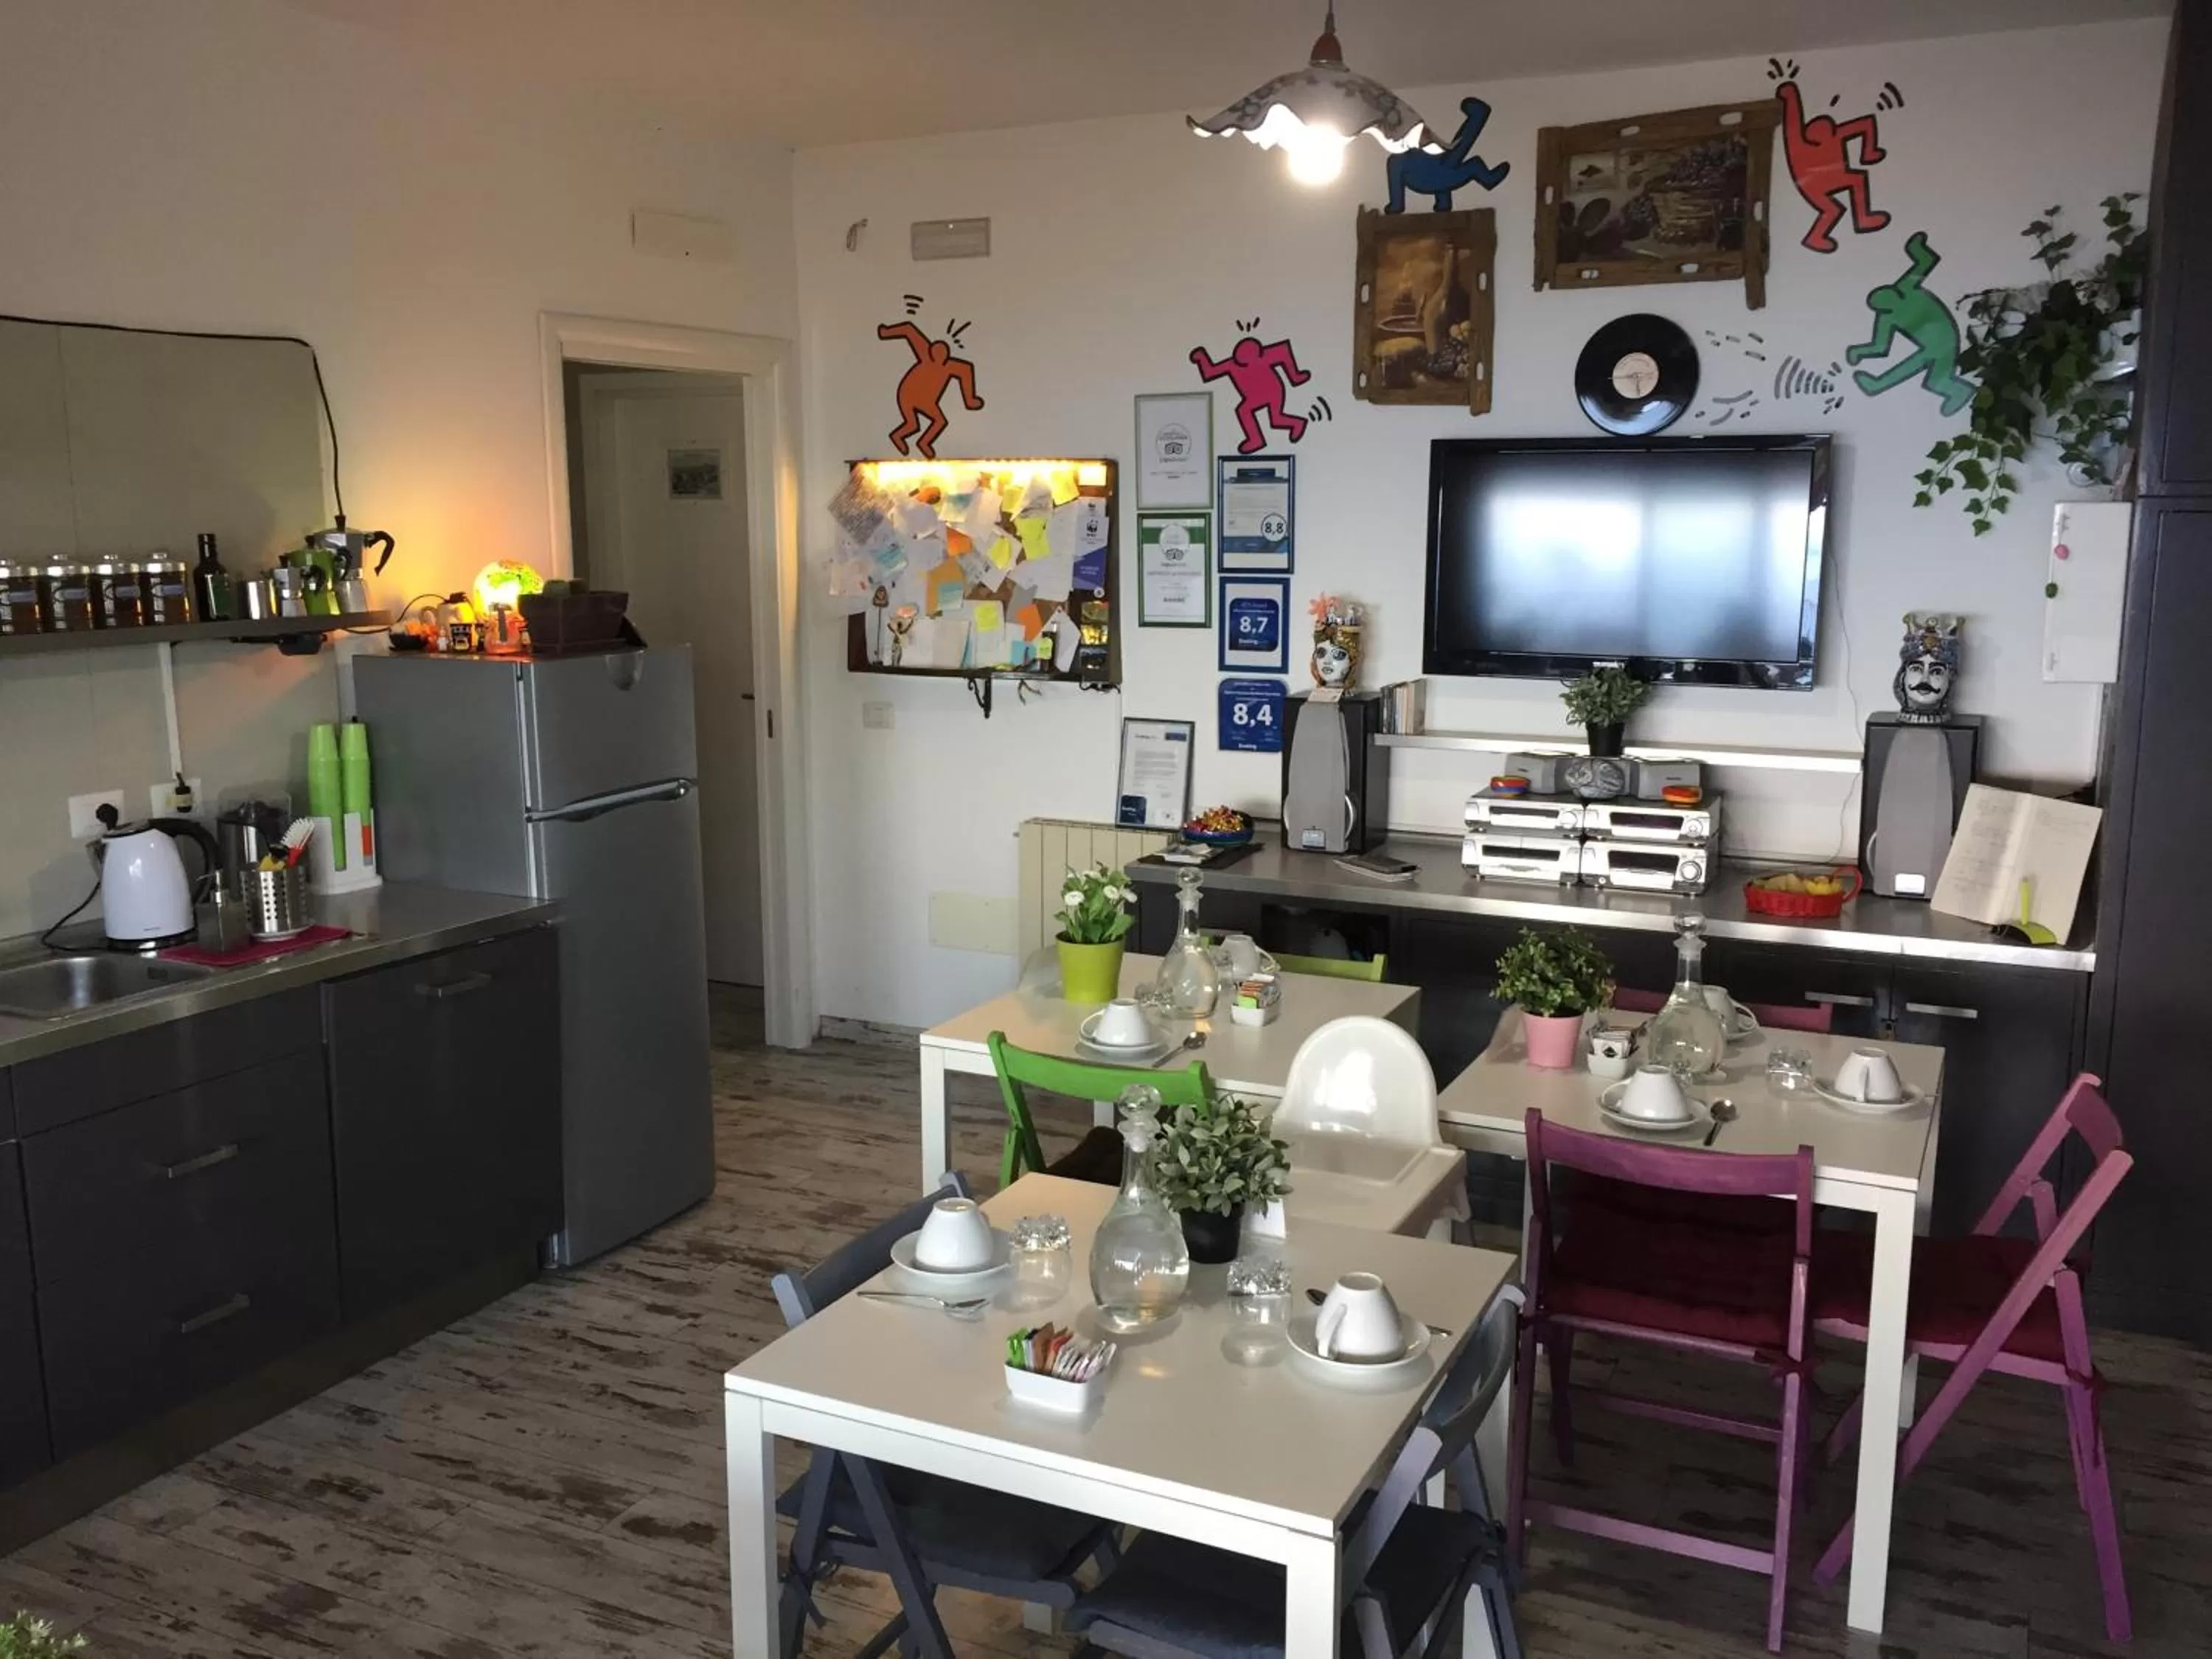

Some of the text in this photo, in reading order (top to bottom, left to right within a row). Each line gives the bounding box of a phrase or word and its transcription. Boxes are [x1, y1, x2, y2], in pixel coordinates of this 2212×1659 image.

[1265, 521, 1284, 535] 8,8
[1239, 616, 1269, 634] 8,7
[1233, 703, 1272, 727] 8,4
